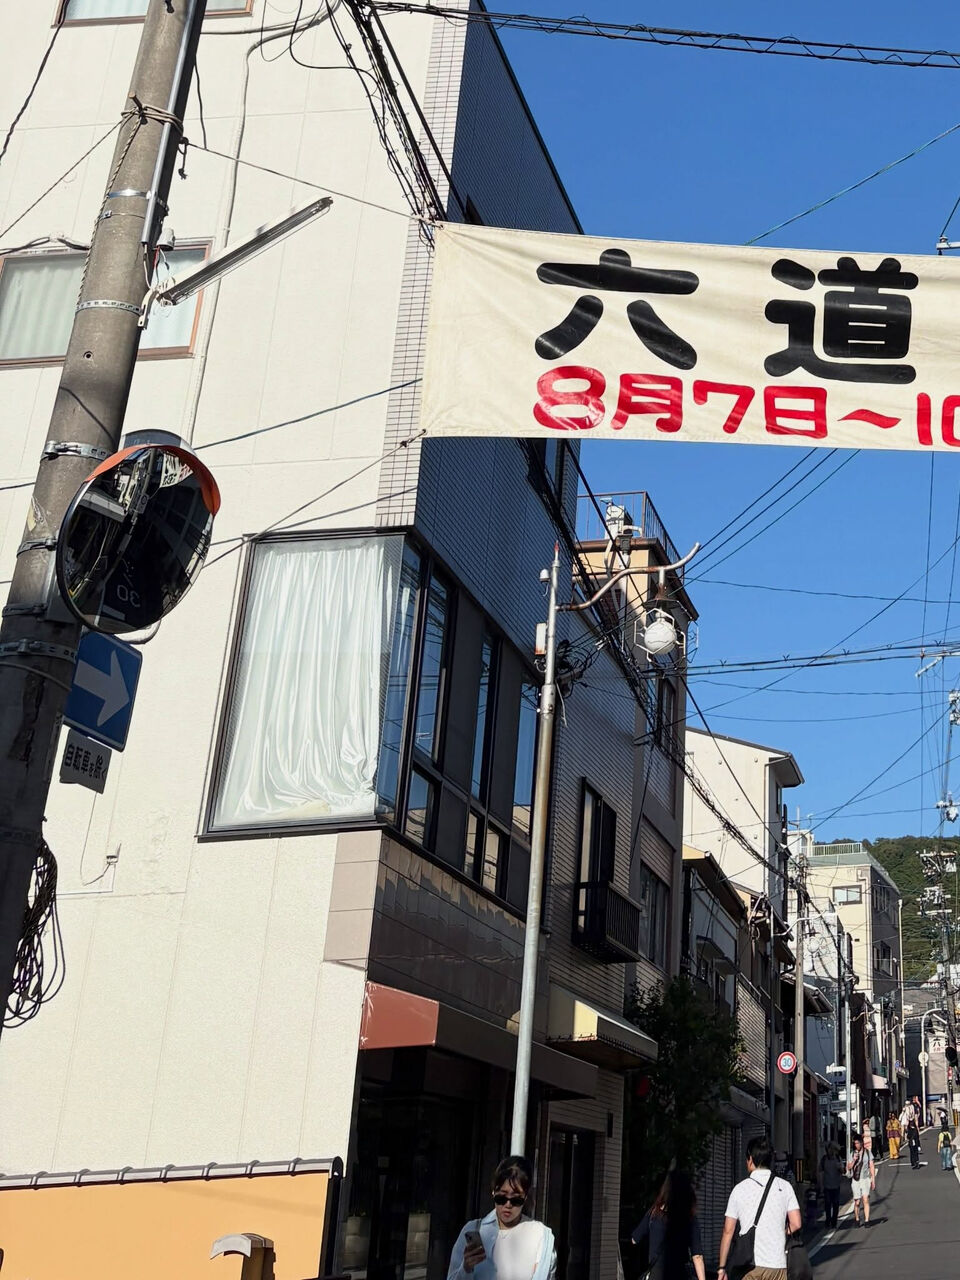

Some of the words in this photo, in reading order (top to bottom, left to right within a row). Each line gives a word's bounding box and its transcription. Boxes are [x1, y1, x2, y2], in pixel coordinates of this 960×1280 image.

[64, 743, 108, 782] 自転車を除く
[783, 1057, 792, 1067] 30
